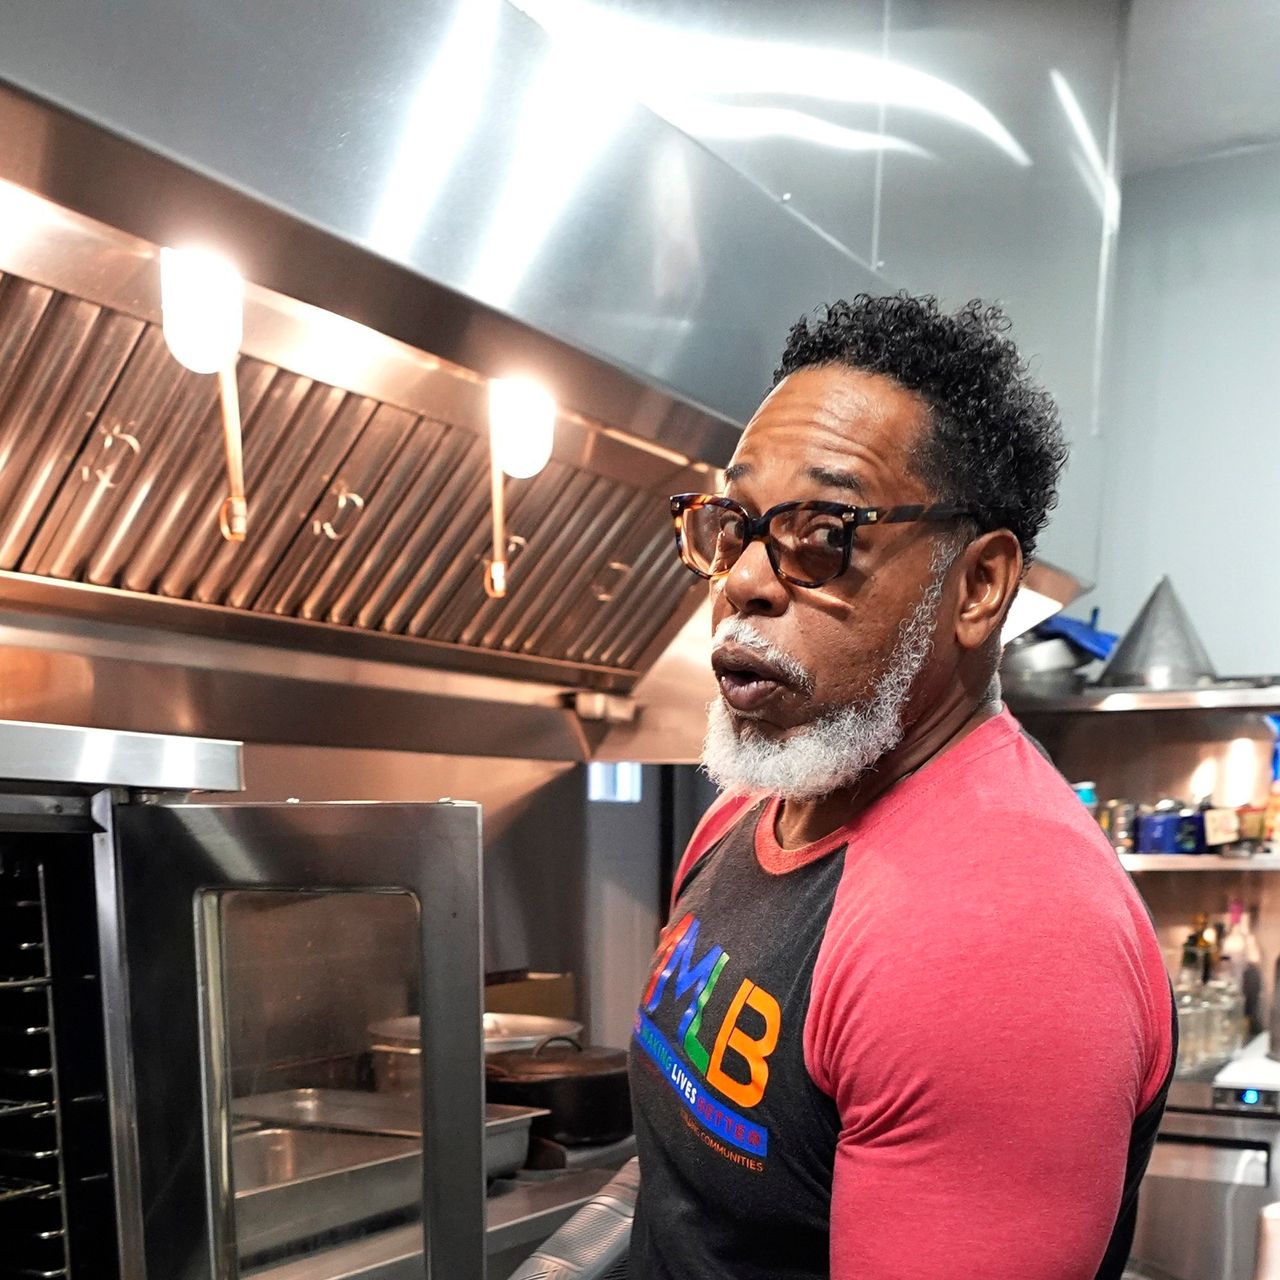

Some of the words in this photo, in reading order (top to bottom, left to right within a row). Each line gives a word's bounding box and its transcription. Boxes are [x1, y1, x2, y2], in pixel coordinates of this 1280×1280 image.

[671, 1063, 697, 1104] LIVES
[697, 1096, 761, 1147] BETTER
[700, 1132, 763, 1172] COMMUNITIES
